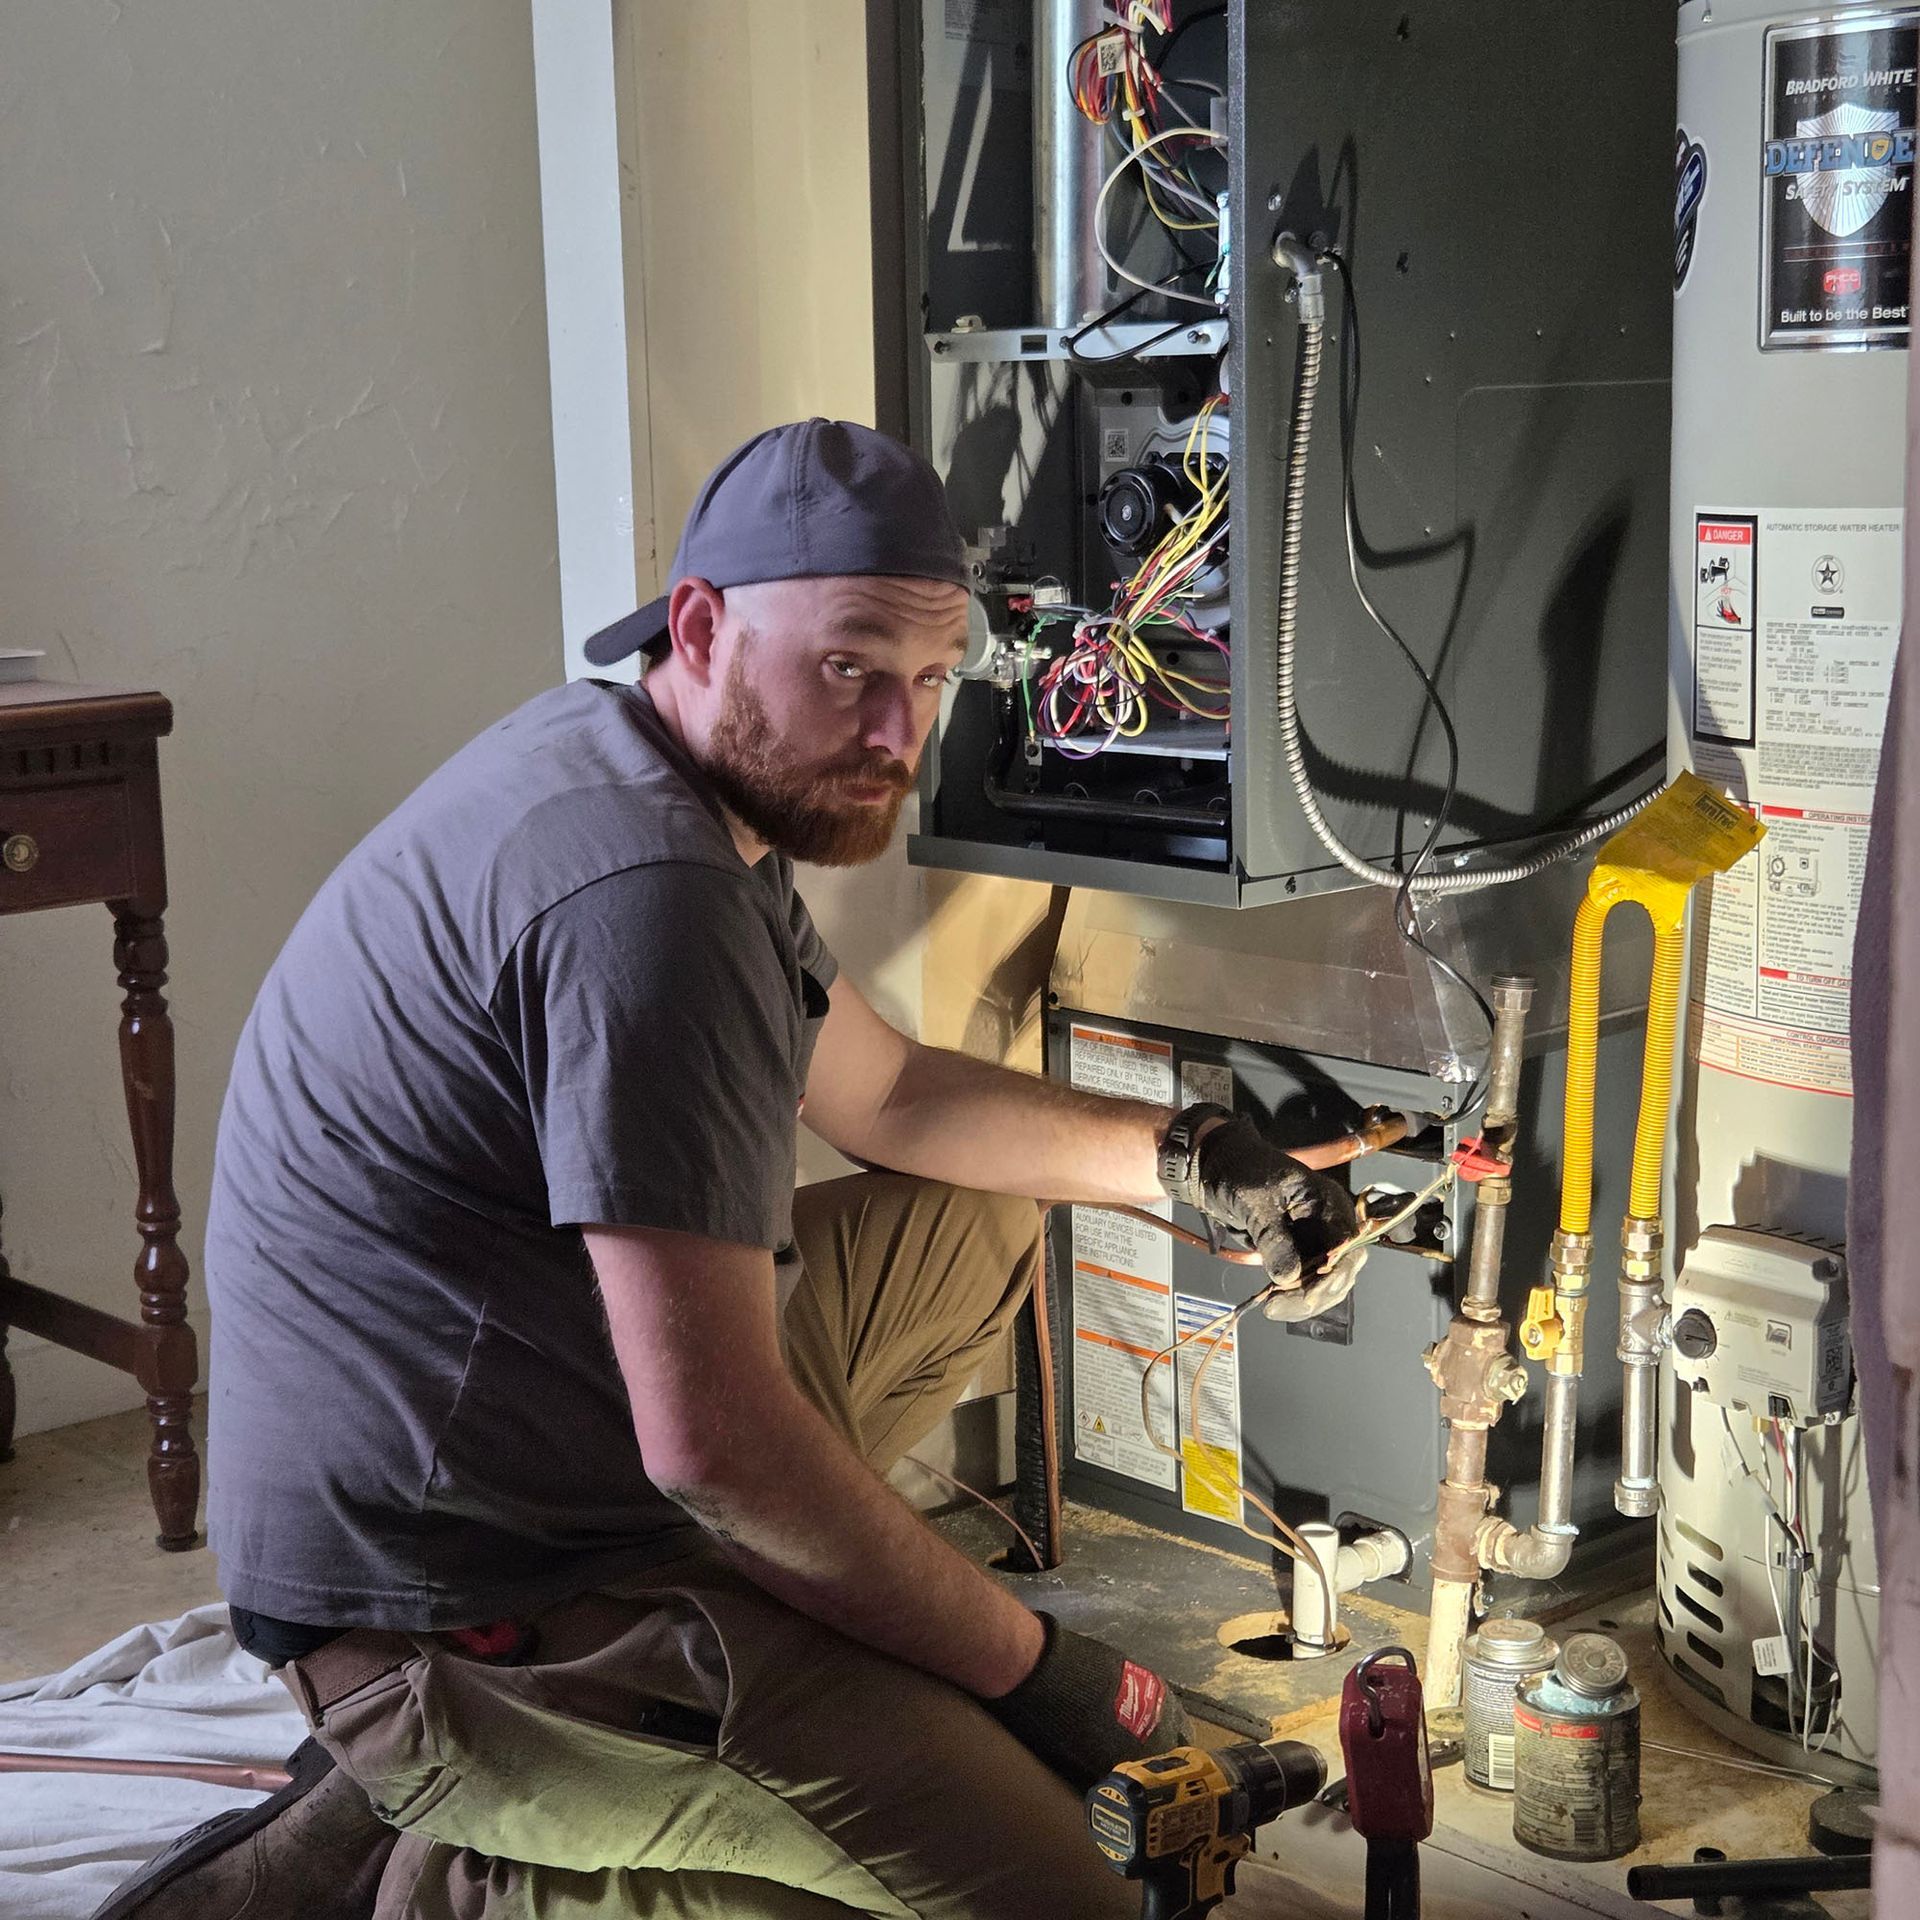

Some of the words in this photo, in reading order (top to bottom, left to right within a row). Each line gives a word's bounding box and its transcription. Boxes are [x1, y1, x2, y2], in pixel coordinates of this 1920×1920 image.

[1785, 75, 1858, 96] BRADFORD
[1862, 68, 1913, 87] WHITE
[1781, 310, 1807, 323] Built
[1809, 311, 1822, 321] to
[1825, 308, 1842, 320] be
[1846, 307, 1868, 319] the
[1872, 305, 1907, 319] Best
[1712, 529, 1744, 541] DANGER
[1766, 523, 1802, 531] AUTOMATIC
[1804, 523, 1838, 531] STORAGE
[1840, 524, 1867, 532] WATER
[1868, 524, 1900, 532] HEATER
[1808, 812, 1845, 821] OPERATING
[1075, 1051, 1118, 1067] REFRIGERANT
[1150, 1064, 1158, 1076] BE
[1075, 1062, 1105, 1075] REPAIRED
[1106, 1067, 1123, 1079] ONLY
[1124, 1070, 1133, 1081] BY
[1135, 1072, 1162, 1087] TRAINED
[1075, 1071, 1100, 1086] SERVICE
[1143, 1086, 1152, 1096] DO
[1153, 1088, 1168, 1100] NOT
[1075, 1223, 1088, 1232] FOR
[1091, 1227, 1102, 1238] USE
[1120, 1235, 1133, 1246] THE
[1135, 1228, 1157, 1242] LISTED
